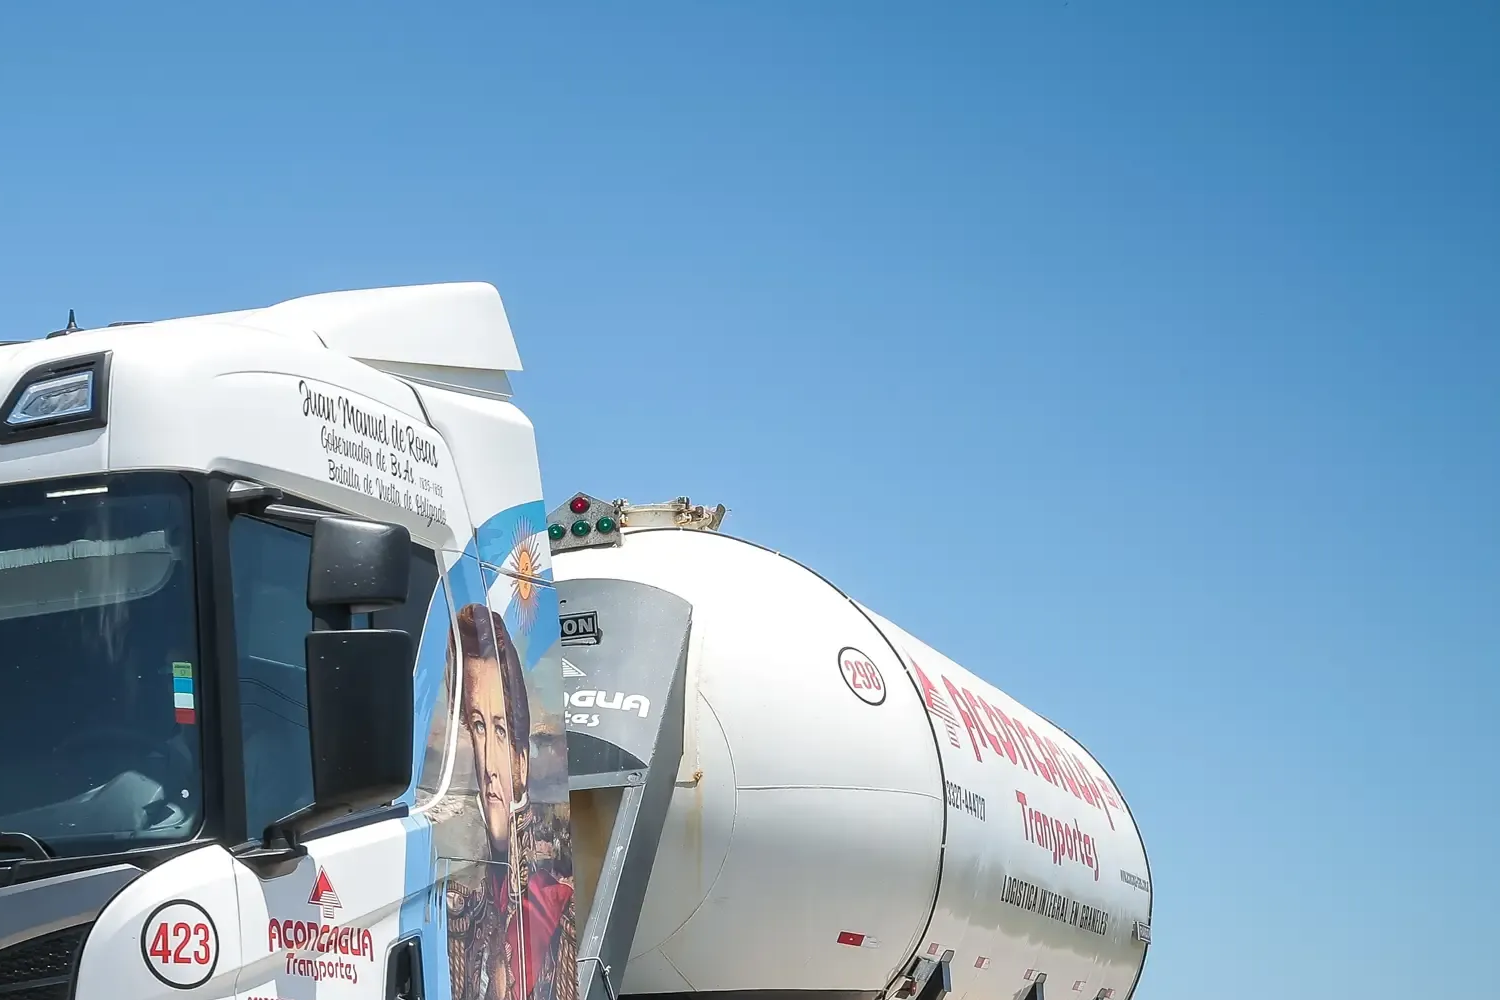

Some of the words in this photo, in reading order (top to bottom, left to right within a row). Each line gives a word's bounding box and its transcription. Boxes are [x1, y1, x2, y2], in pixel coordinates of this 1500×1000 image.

[299, 380, 338, 424] Juan
[338, 395, 390, 446] Manuel
[391, 420, 407, 453] de
[406, 426, 438, 468] Rosas
[320, 425, 373, 467] Gobernador
[376, 448, 387, 473] de
[327, 459, 361, 492] Batalla
[363, 473, 374, 496] de
[375, 477, 401, 507] Vuelta
[403, 490, 414, 512] de
[415, 493, 447, 527] Obligado
[844, 659, 882, 691] 298
[563, 689, 651, 718] GUA
[946, 779, 986, 823] 3327-444727
[1015, 789, 1100, 882] Transportes
[1000, 874, 1038, 912] LOGISTICA
[1038, 888, 1069, 923] INTEGRAL
[1069, 900, 1080, 926] EN
[1079, 904, 1109, 936] GRANELES
[149, 922, 211, 966] 423
[268, 918, 375, 963] ACONCAGUA
[285, 953, 358, 985] Transportes
